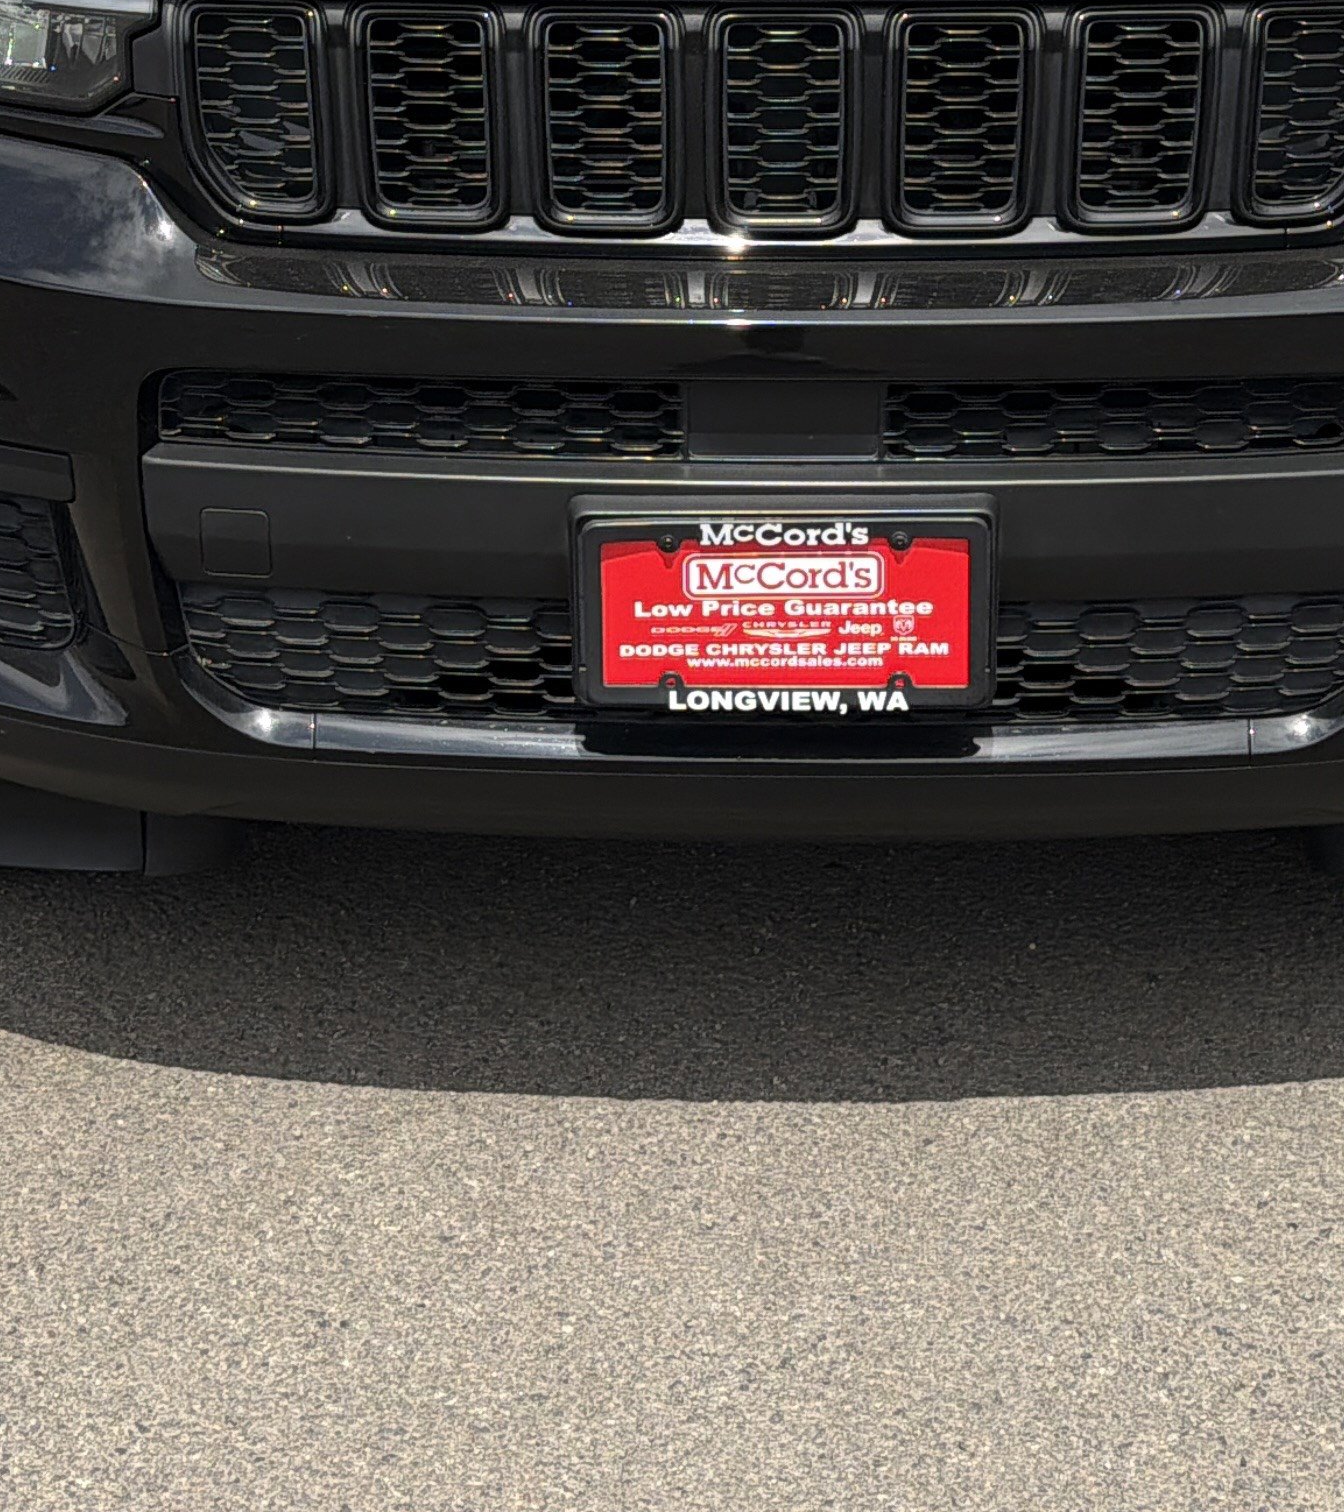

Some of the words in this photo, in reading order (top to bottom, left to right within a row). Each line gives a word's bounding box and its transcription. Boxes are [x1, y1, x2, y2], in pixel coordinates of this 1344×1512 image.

[699, 522, 869, 547] McCord's
[696, 561, 872, 590] McCord's
[634, 600, 694, 618] Low
[701, 600, 776, 617] Price
[784, 599, 934, 616] Guarantee
[742, 620, 832, 629] CHRYSLER
[838, 620, 884, 637] Jeep
[619, 643, 700, 658] DODGE
[705, 642, 828, 656] CHRYSLER
[833, 642, 892, 656] JEEP
[898, 642, 950, 656] RAM
[686, 655, 884, 668] www.mccordsales.com
[668, 690, 849, 715] LONGVIEW,
[857, 690, 910, 712] WA
